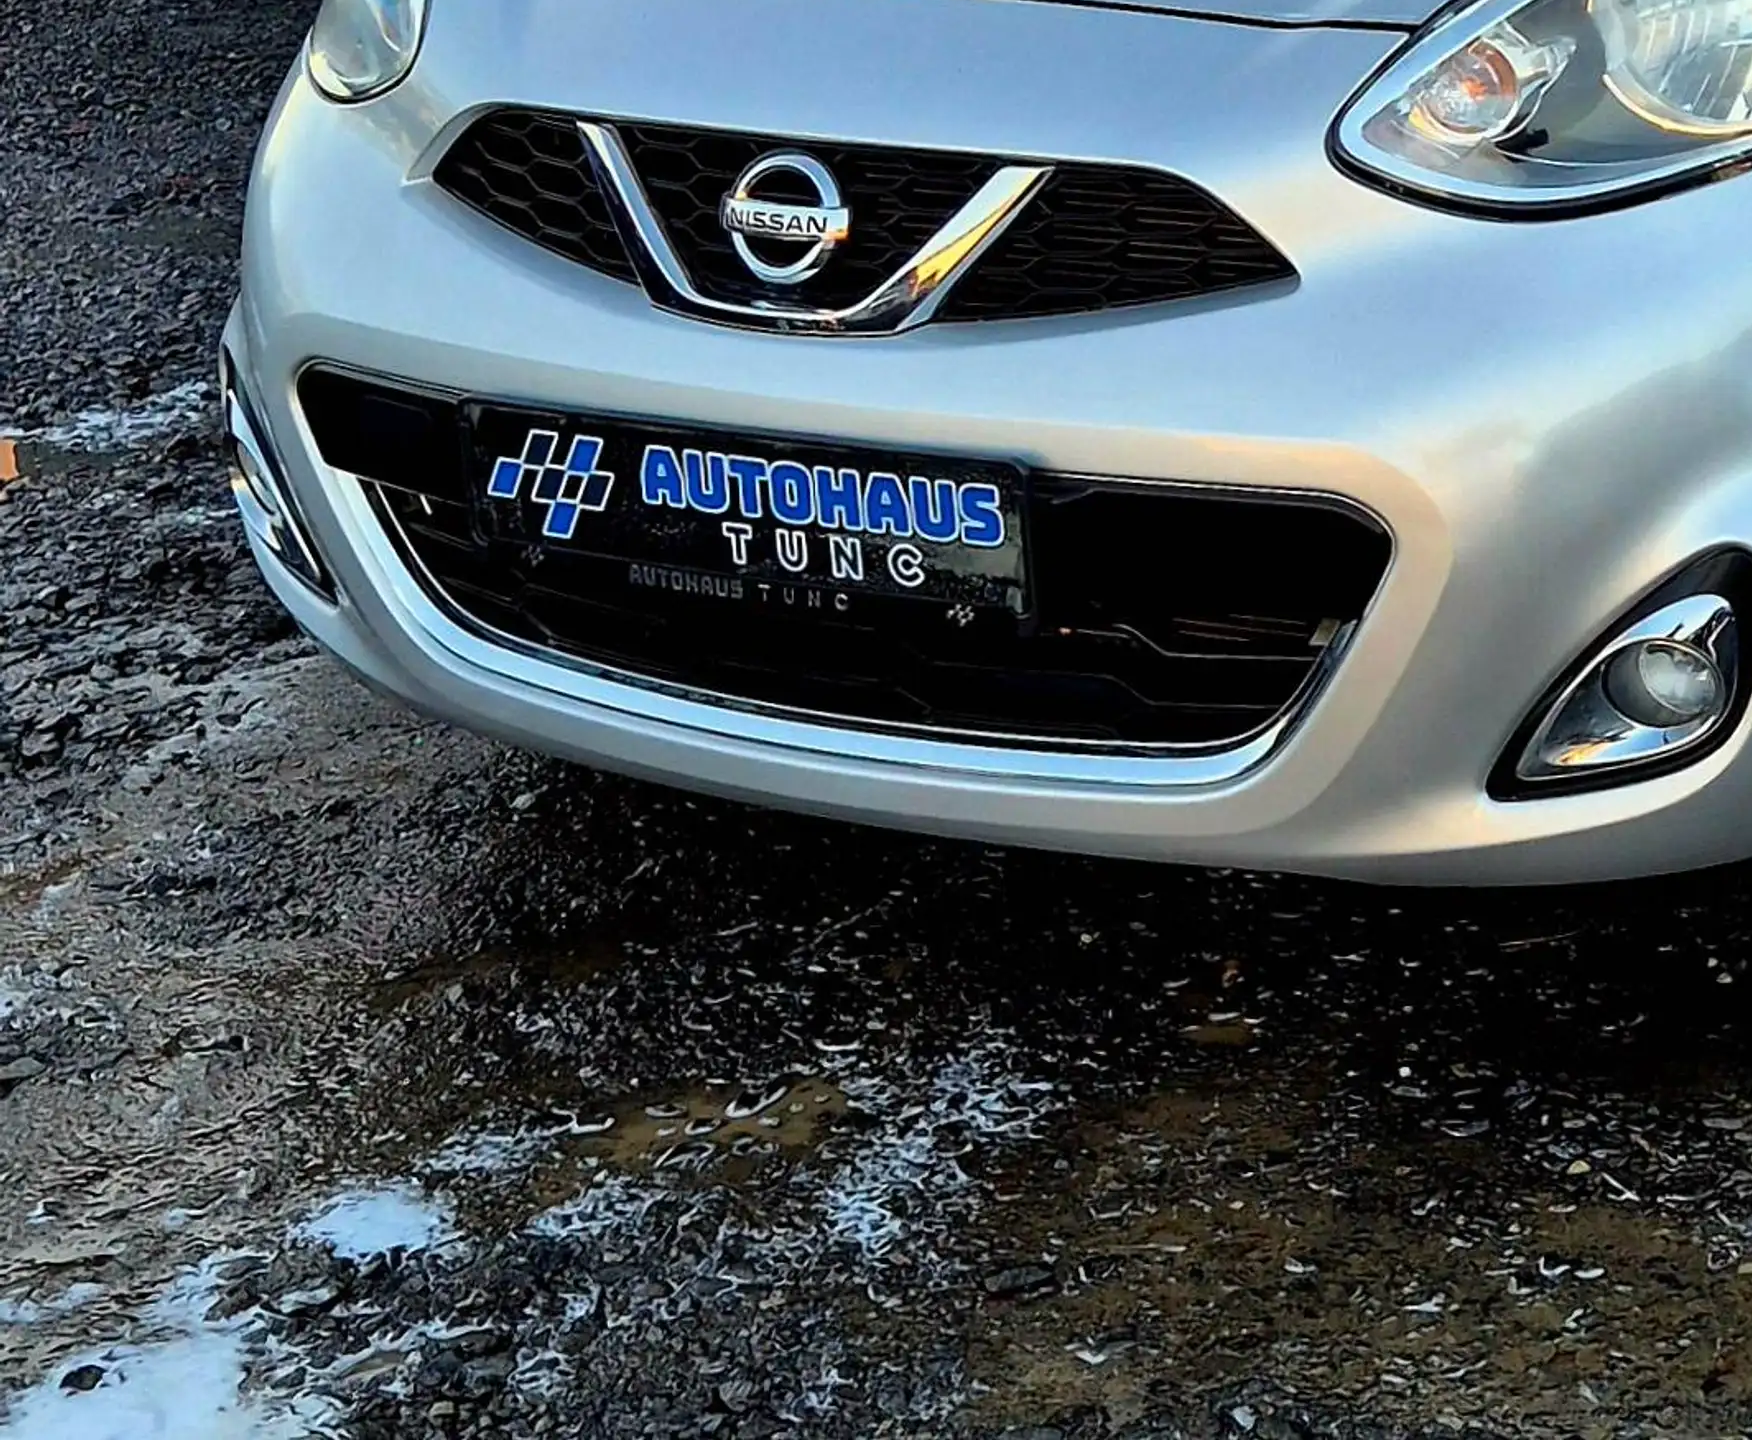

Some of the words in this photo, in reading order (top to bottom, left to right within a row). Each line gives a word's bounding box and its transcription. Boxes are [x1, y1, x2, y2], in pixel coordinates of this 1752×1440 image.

[730, 207, 828, 233] NISSAN
[641, 445, 1004, 546] AUTOHAUS
[723, 522, 925, 587] TUNC
[629, 563, 744, 599] AUTOHAUS
[757, 583, 849, 611] TUNC
